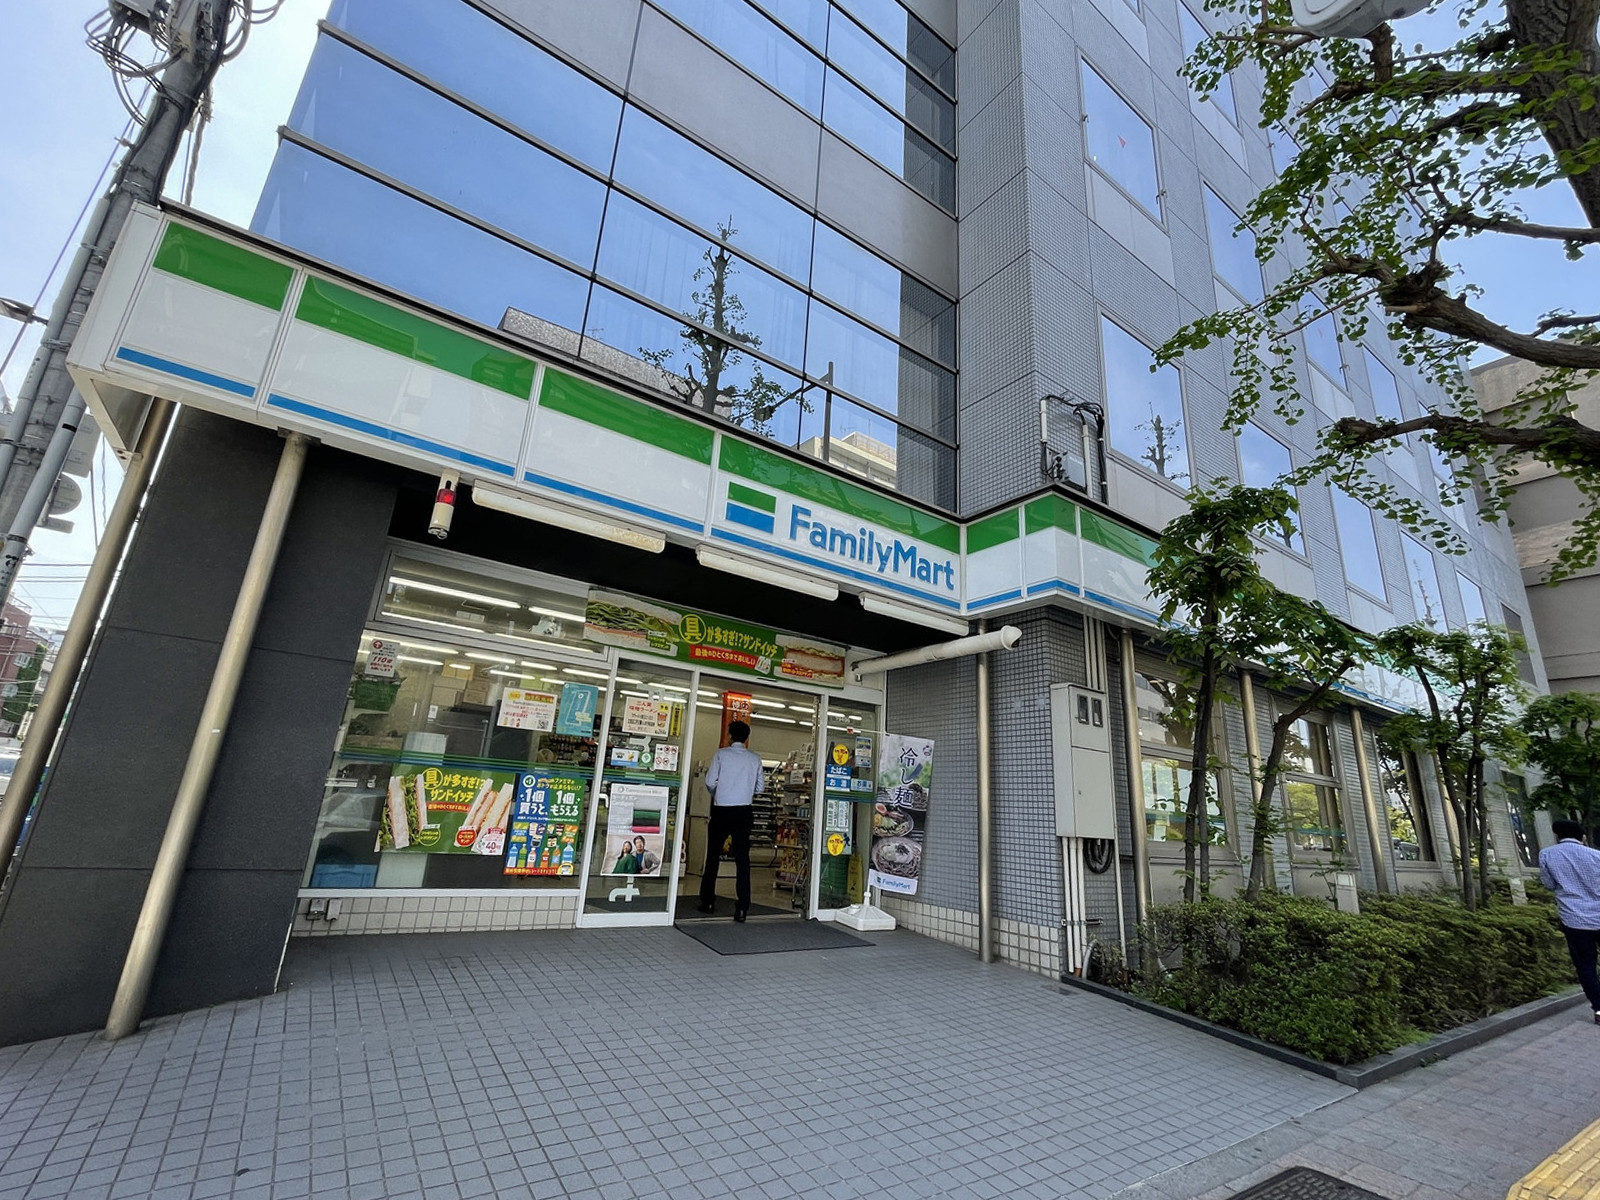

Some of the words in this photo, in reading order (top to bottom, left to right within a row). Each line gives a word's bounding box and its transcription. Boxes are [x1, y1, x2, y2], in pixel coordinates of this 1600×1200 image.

[789, 503, 955, 591] FamilyMart
[830, 766, 848, 775] たばこ
[430, 788, 475, 803] サンドイッチ
[550, 804, 579, 816] もらえる
[882, 879, 912, 890] FamilyMart
